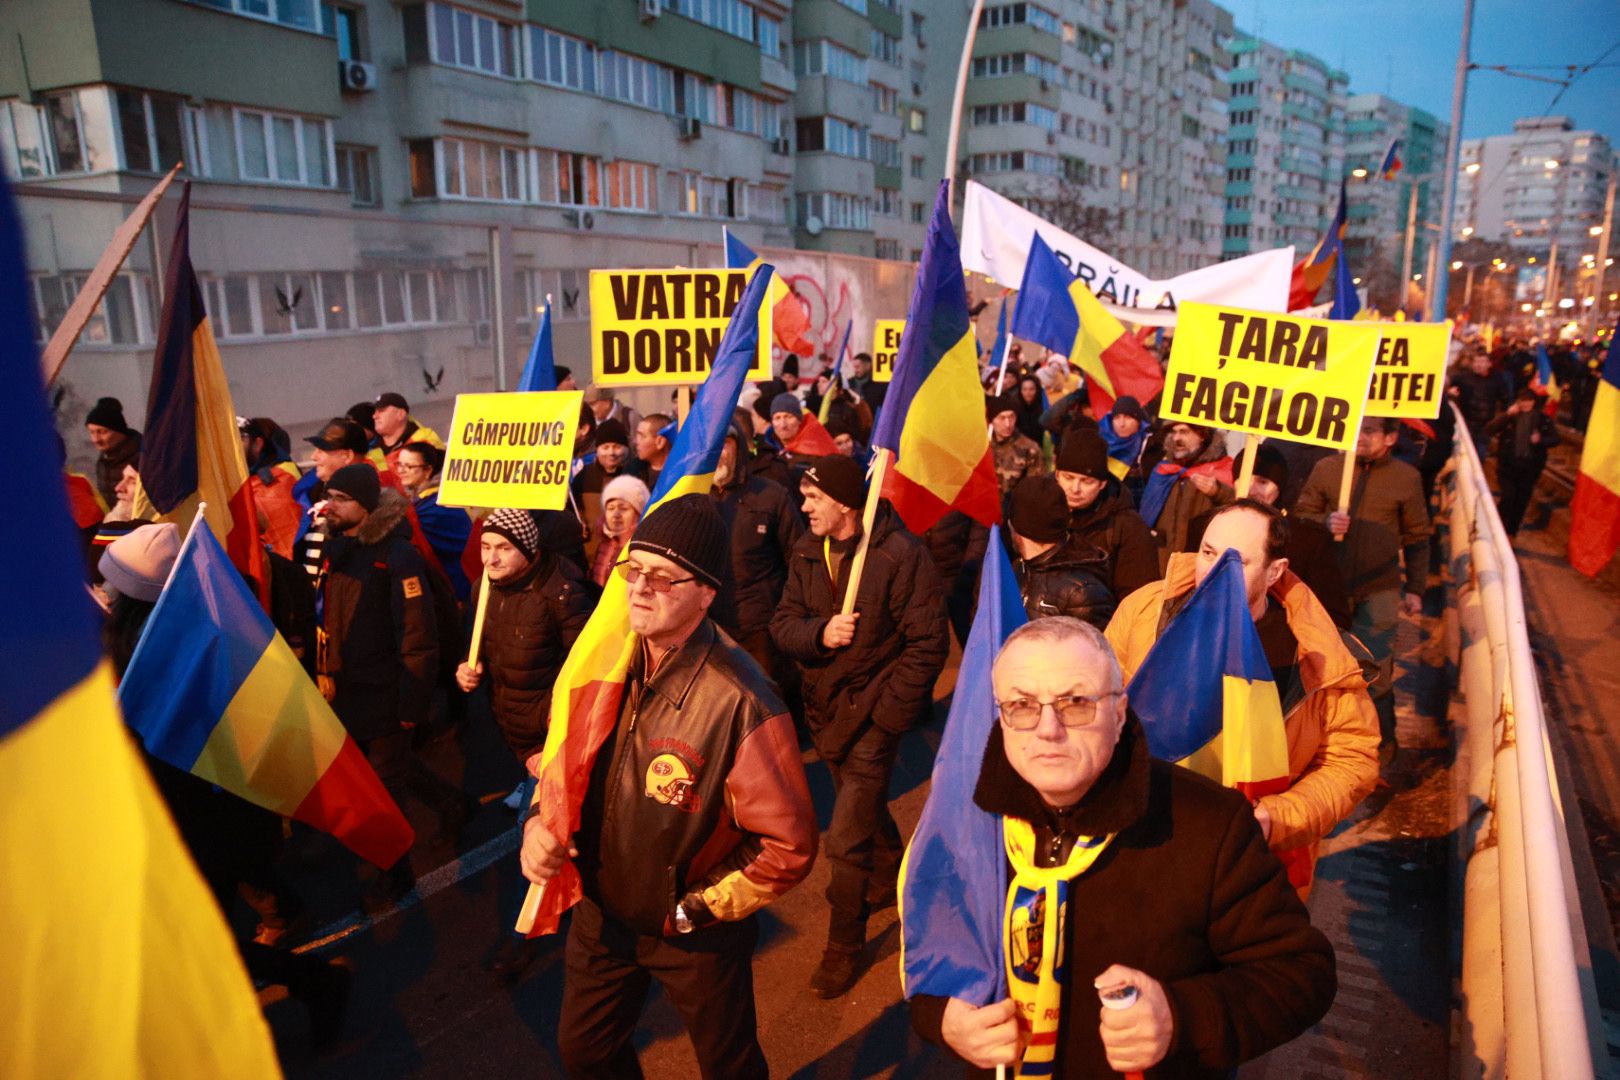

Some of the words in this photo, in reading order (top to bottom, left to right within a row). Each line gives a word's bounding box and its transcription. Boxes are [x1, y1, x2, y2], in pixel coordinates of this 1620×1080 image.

[602, 327, 759, 375] DORN
[1218, 312, 1329, 371] ȚARA
[1170, 373, 1350, 442] FAGILOR
[462, 418, 565, 446] CÂMPULUNG
[447, 458, 567, 485] MOLDOVENESC
